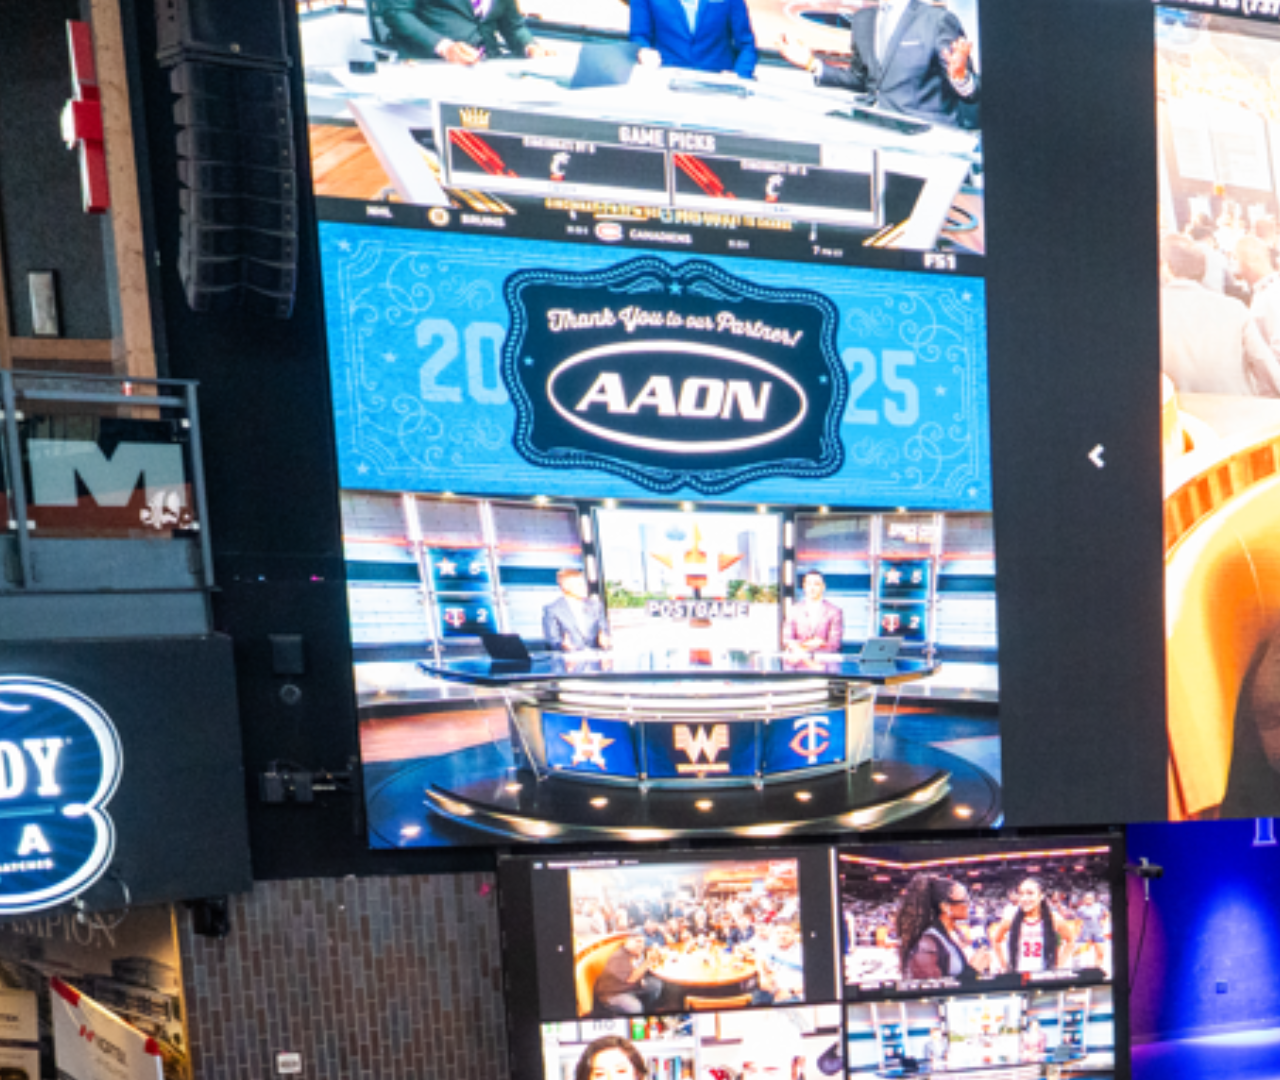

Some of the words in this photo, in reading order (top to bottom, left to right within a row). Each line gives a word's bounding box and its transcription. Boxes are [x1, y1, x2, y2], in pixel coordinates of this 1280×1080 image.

[547, 308, 616, 332] Thank
[618, 306, 664, 333] You
[665, 311, 683, 327] to
[685, 315, 713, 331] our
[715, 311, 803, 347] Partner!
[573, 371, 774, 422] AAON
[842, 346, 920, 427] 25
